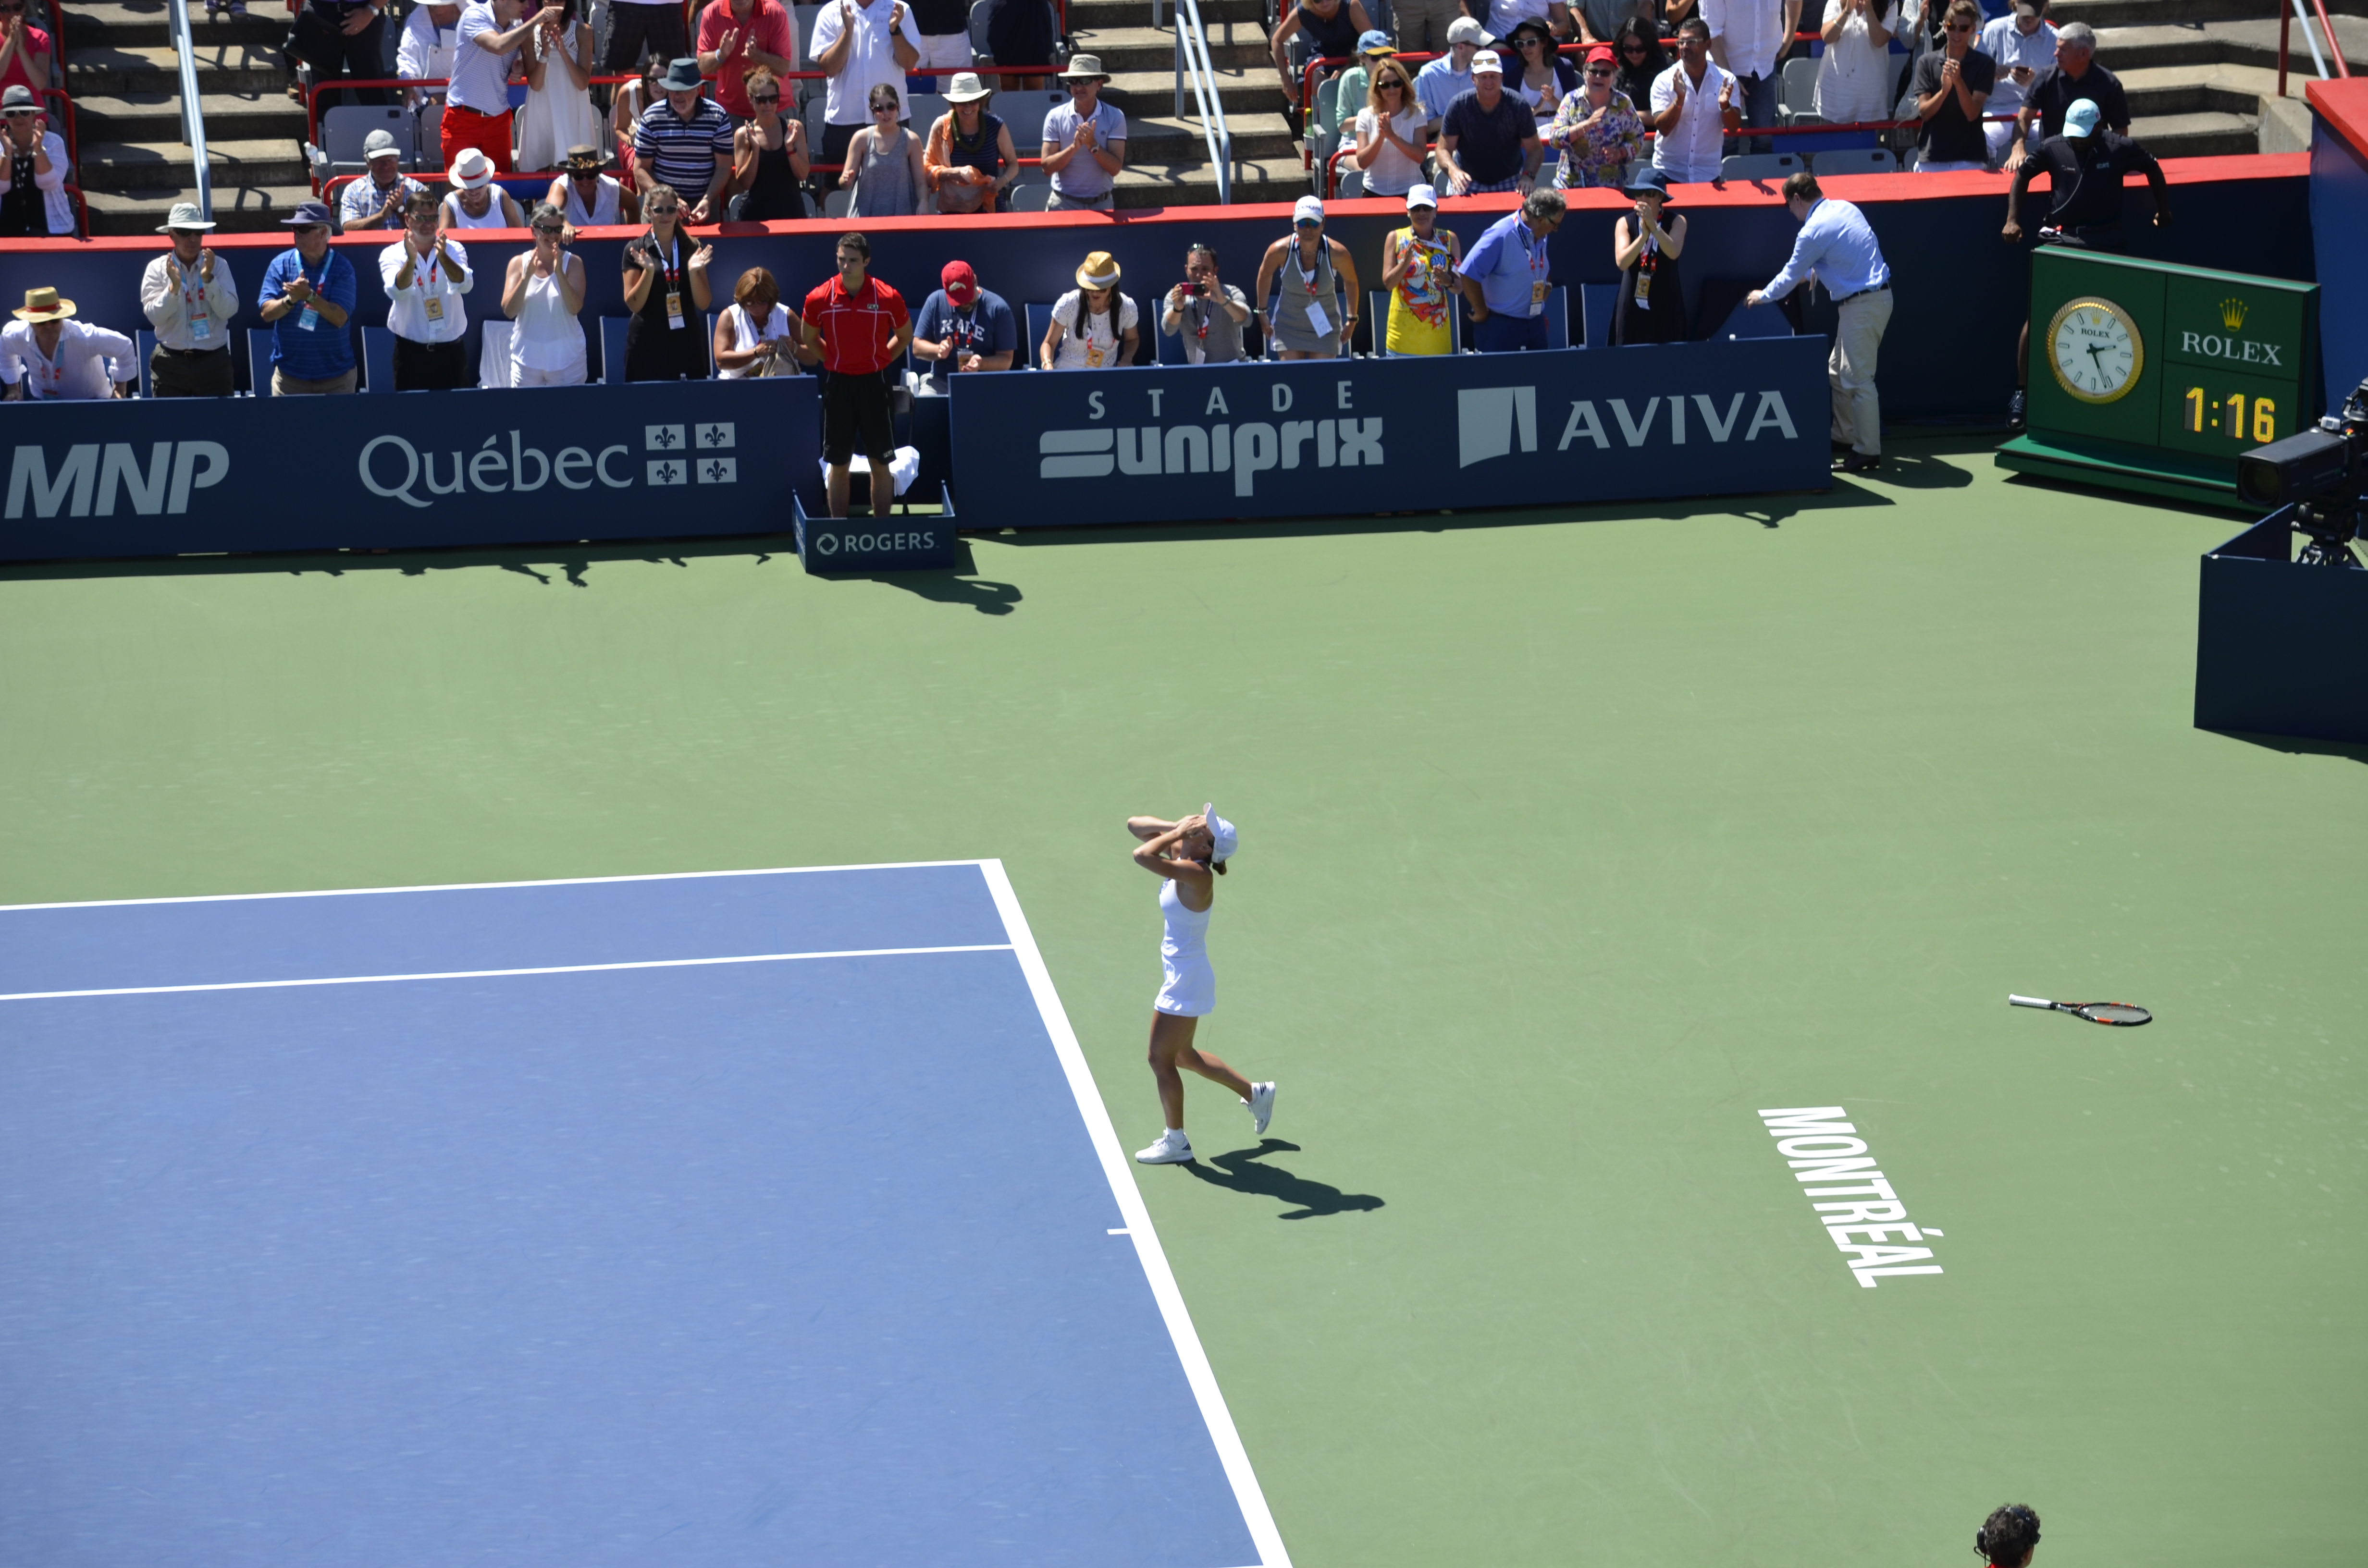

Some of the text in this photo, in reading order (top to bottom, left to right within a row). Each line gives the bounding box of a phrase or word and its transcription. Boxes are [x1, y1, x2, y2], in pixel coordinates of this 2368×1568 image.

[2081, 328, 2110, 338] ROLEX
[2181, 331, 2282, 366] ROLEX
[1088, 380, 1353, 420] STADE
[1557, 391, 1798, 451] AVIVA
[2186, 387, 2275, 443] 1:16
[4, 441, 230, 519] MNP
[359, 429, 633, 507] Québec
[845, 532, 935, 552] ROGERS
[1758, 1106, 1944, 1288] MONTRÉAL
